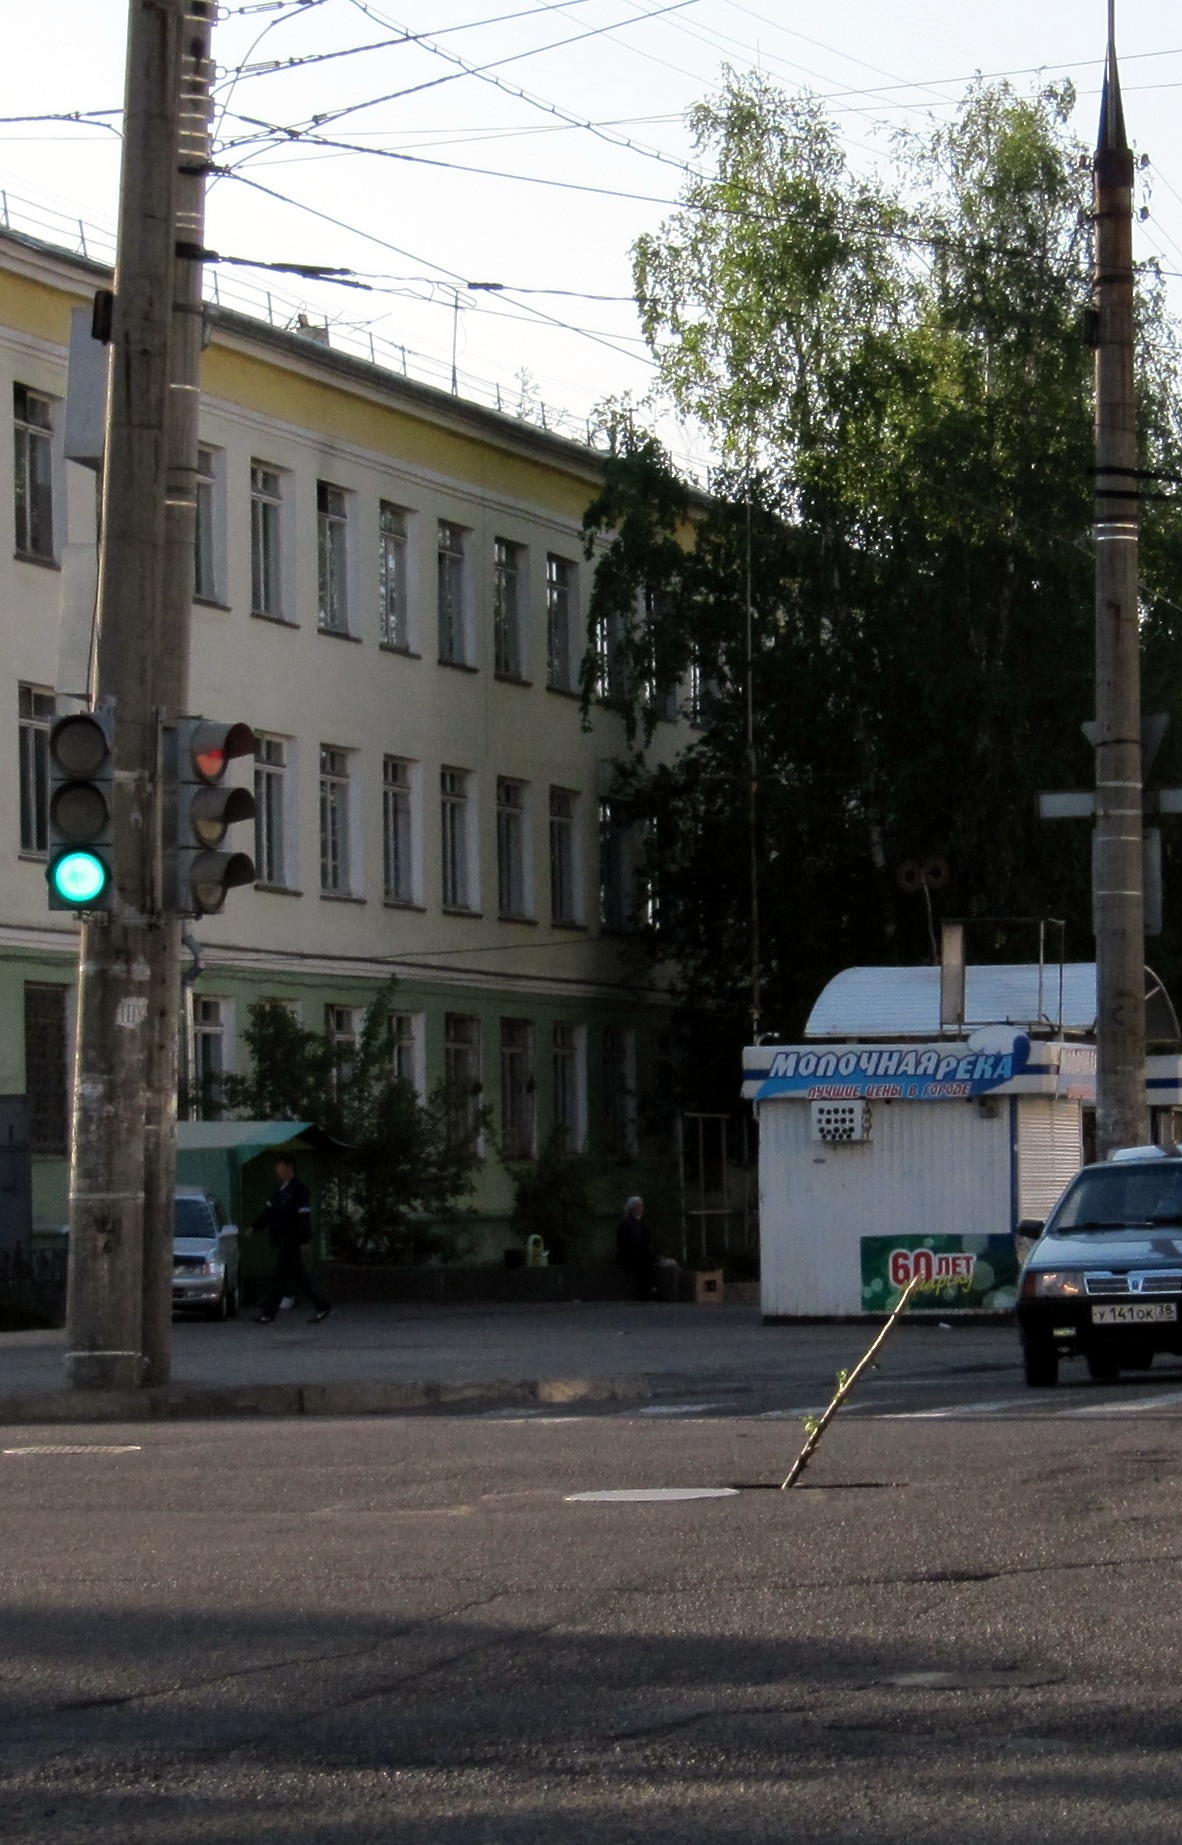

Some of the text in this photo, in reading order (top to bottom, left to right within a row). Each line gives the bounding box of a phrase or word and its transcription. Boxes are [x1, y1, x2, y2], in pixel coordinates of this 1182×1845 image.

[807, 1082, 972, 1099] ЛУЧШИЕ ЦЕНЫ В ГОРОДЕ
[890, 1249, 975, 1286] 60 ЛЕТ
